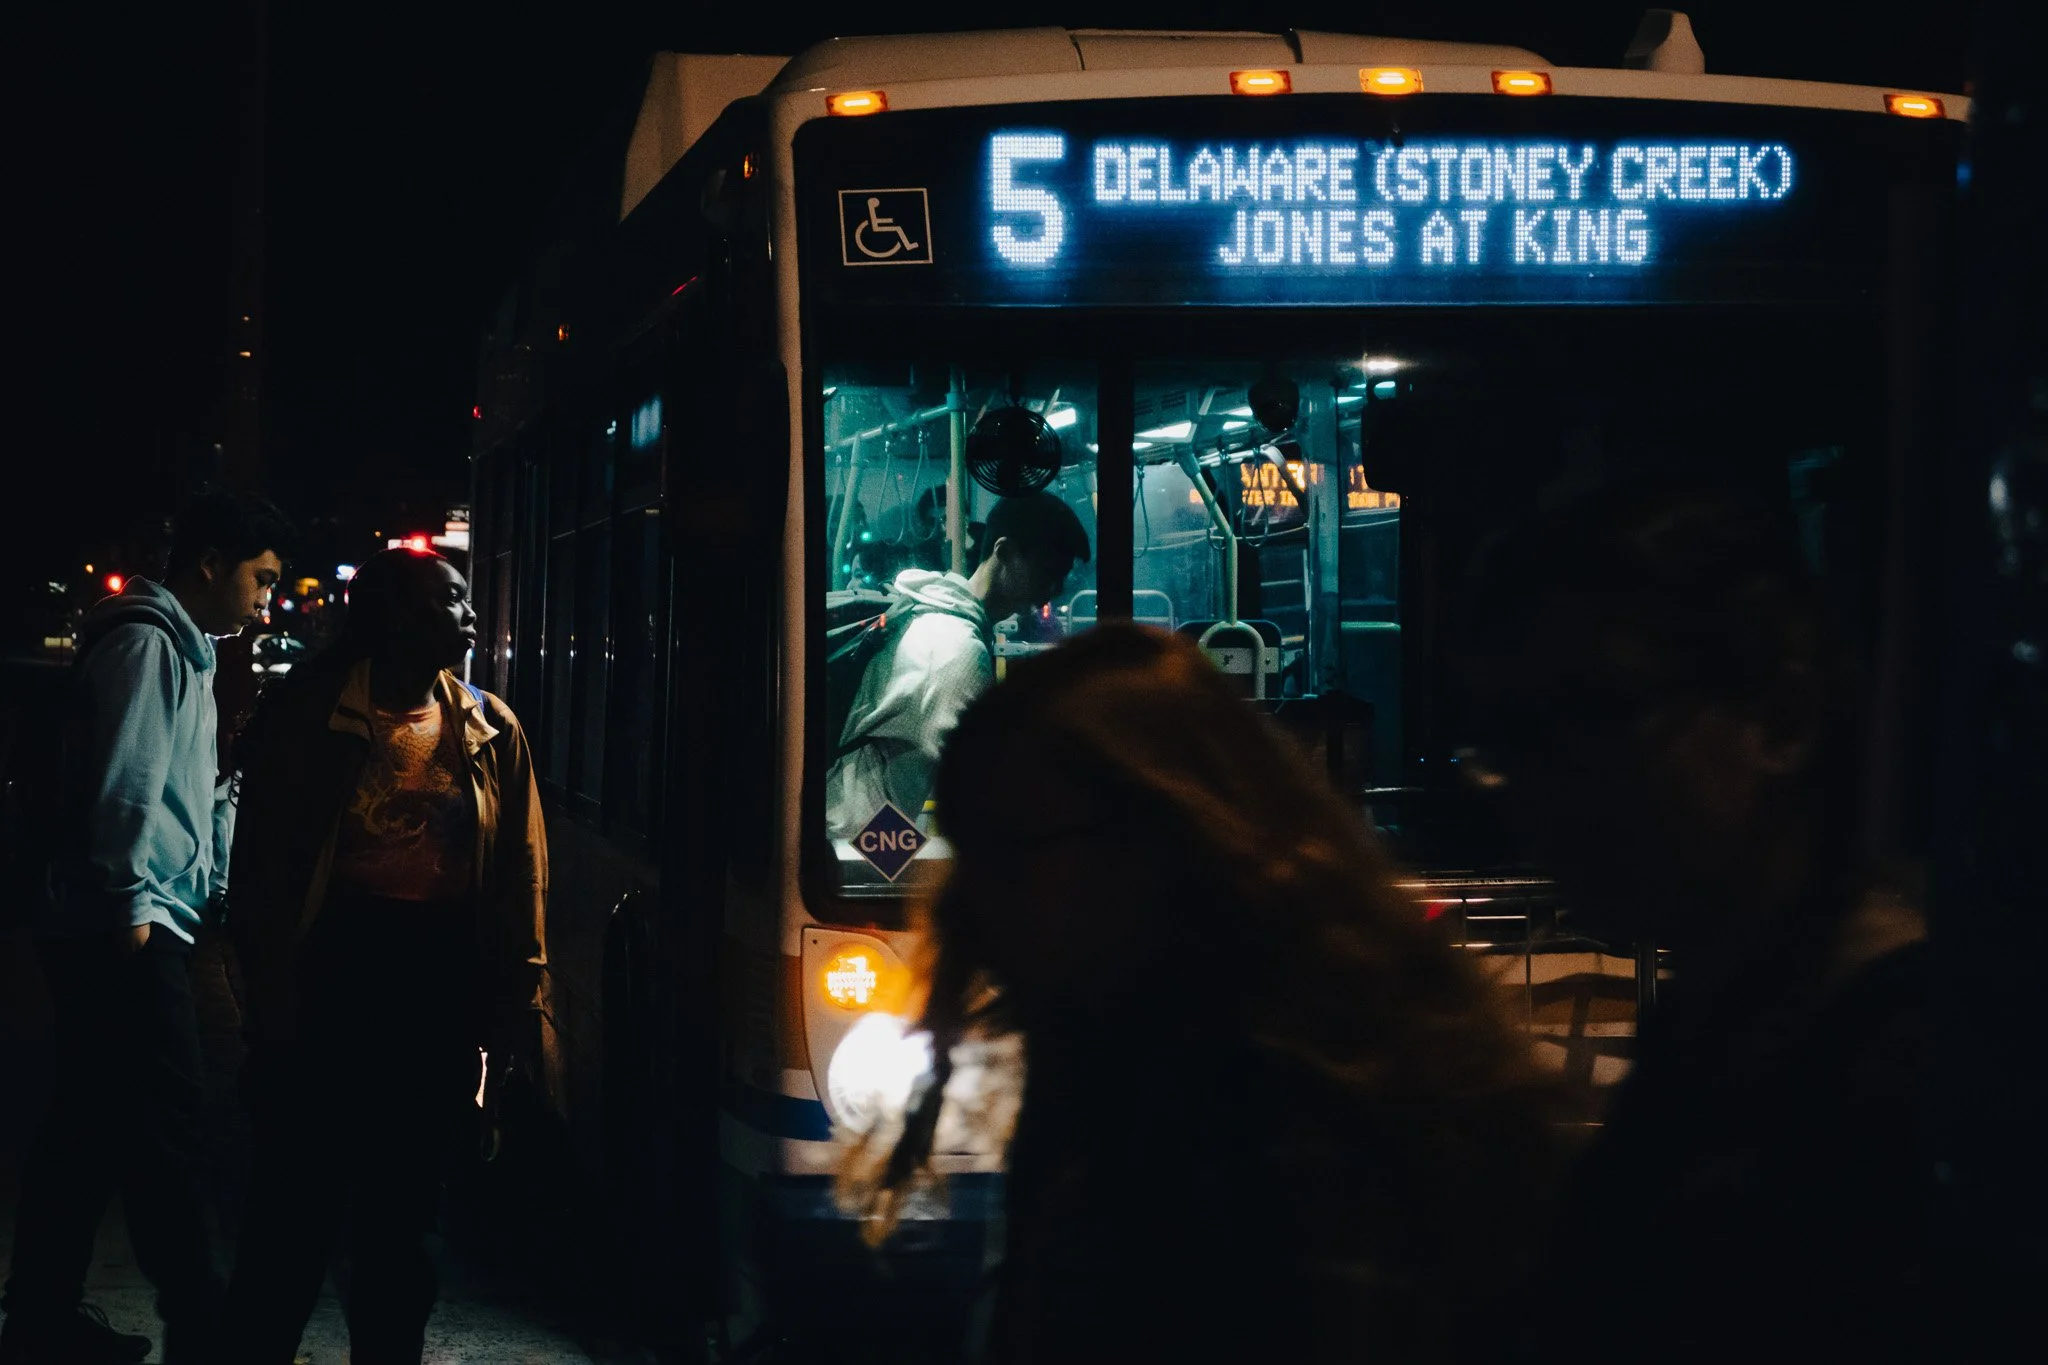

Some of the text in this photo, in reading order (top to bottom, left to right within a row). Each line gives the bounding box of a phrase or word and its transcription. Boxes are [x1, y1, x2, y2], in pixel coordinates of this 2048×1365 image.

[989, 134, 1066, 266] 5
[1093, 144, 1793, 202] DELAWARE (STONEY CREEK)
[1218, 208, 1649, 265] JONES AT KING
[859, 828, 918, 853] CNG
